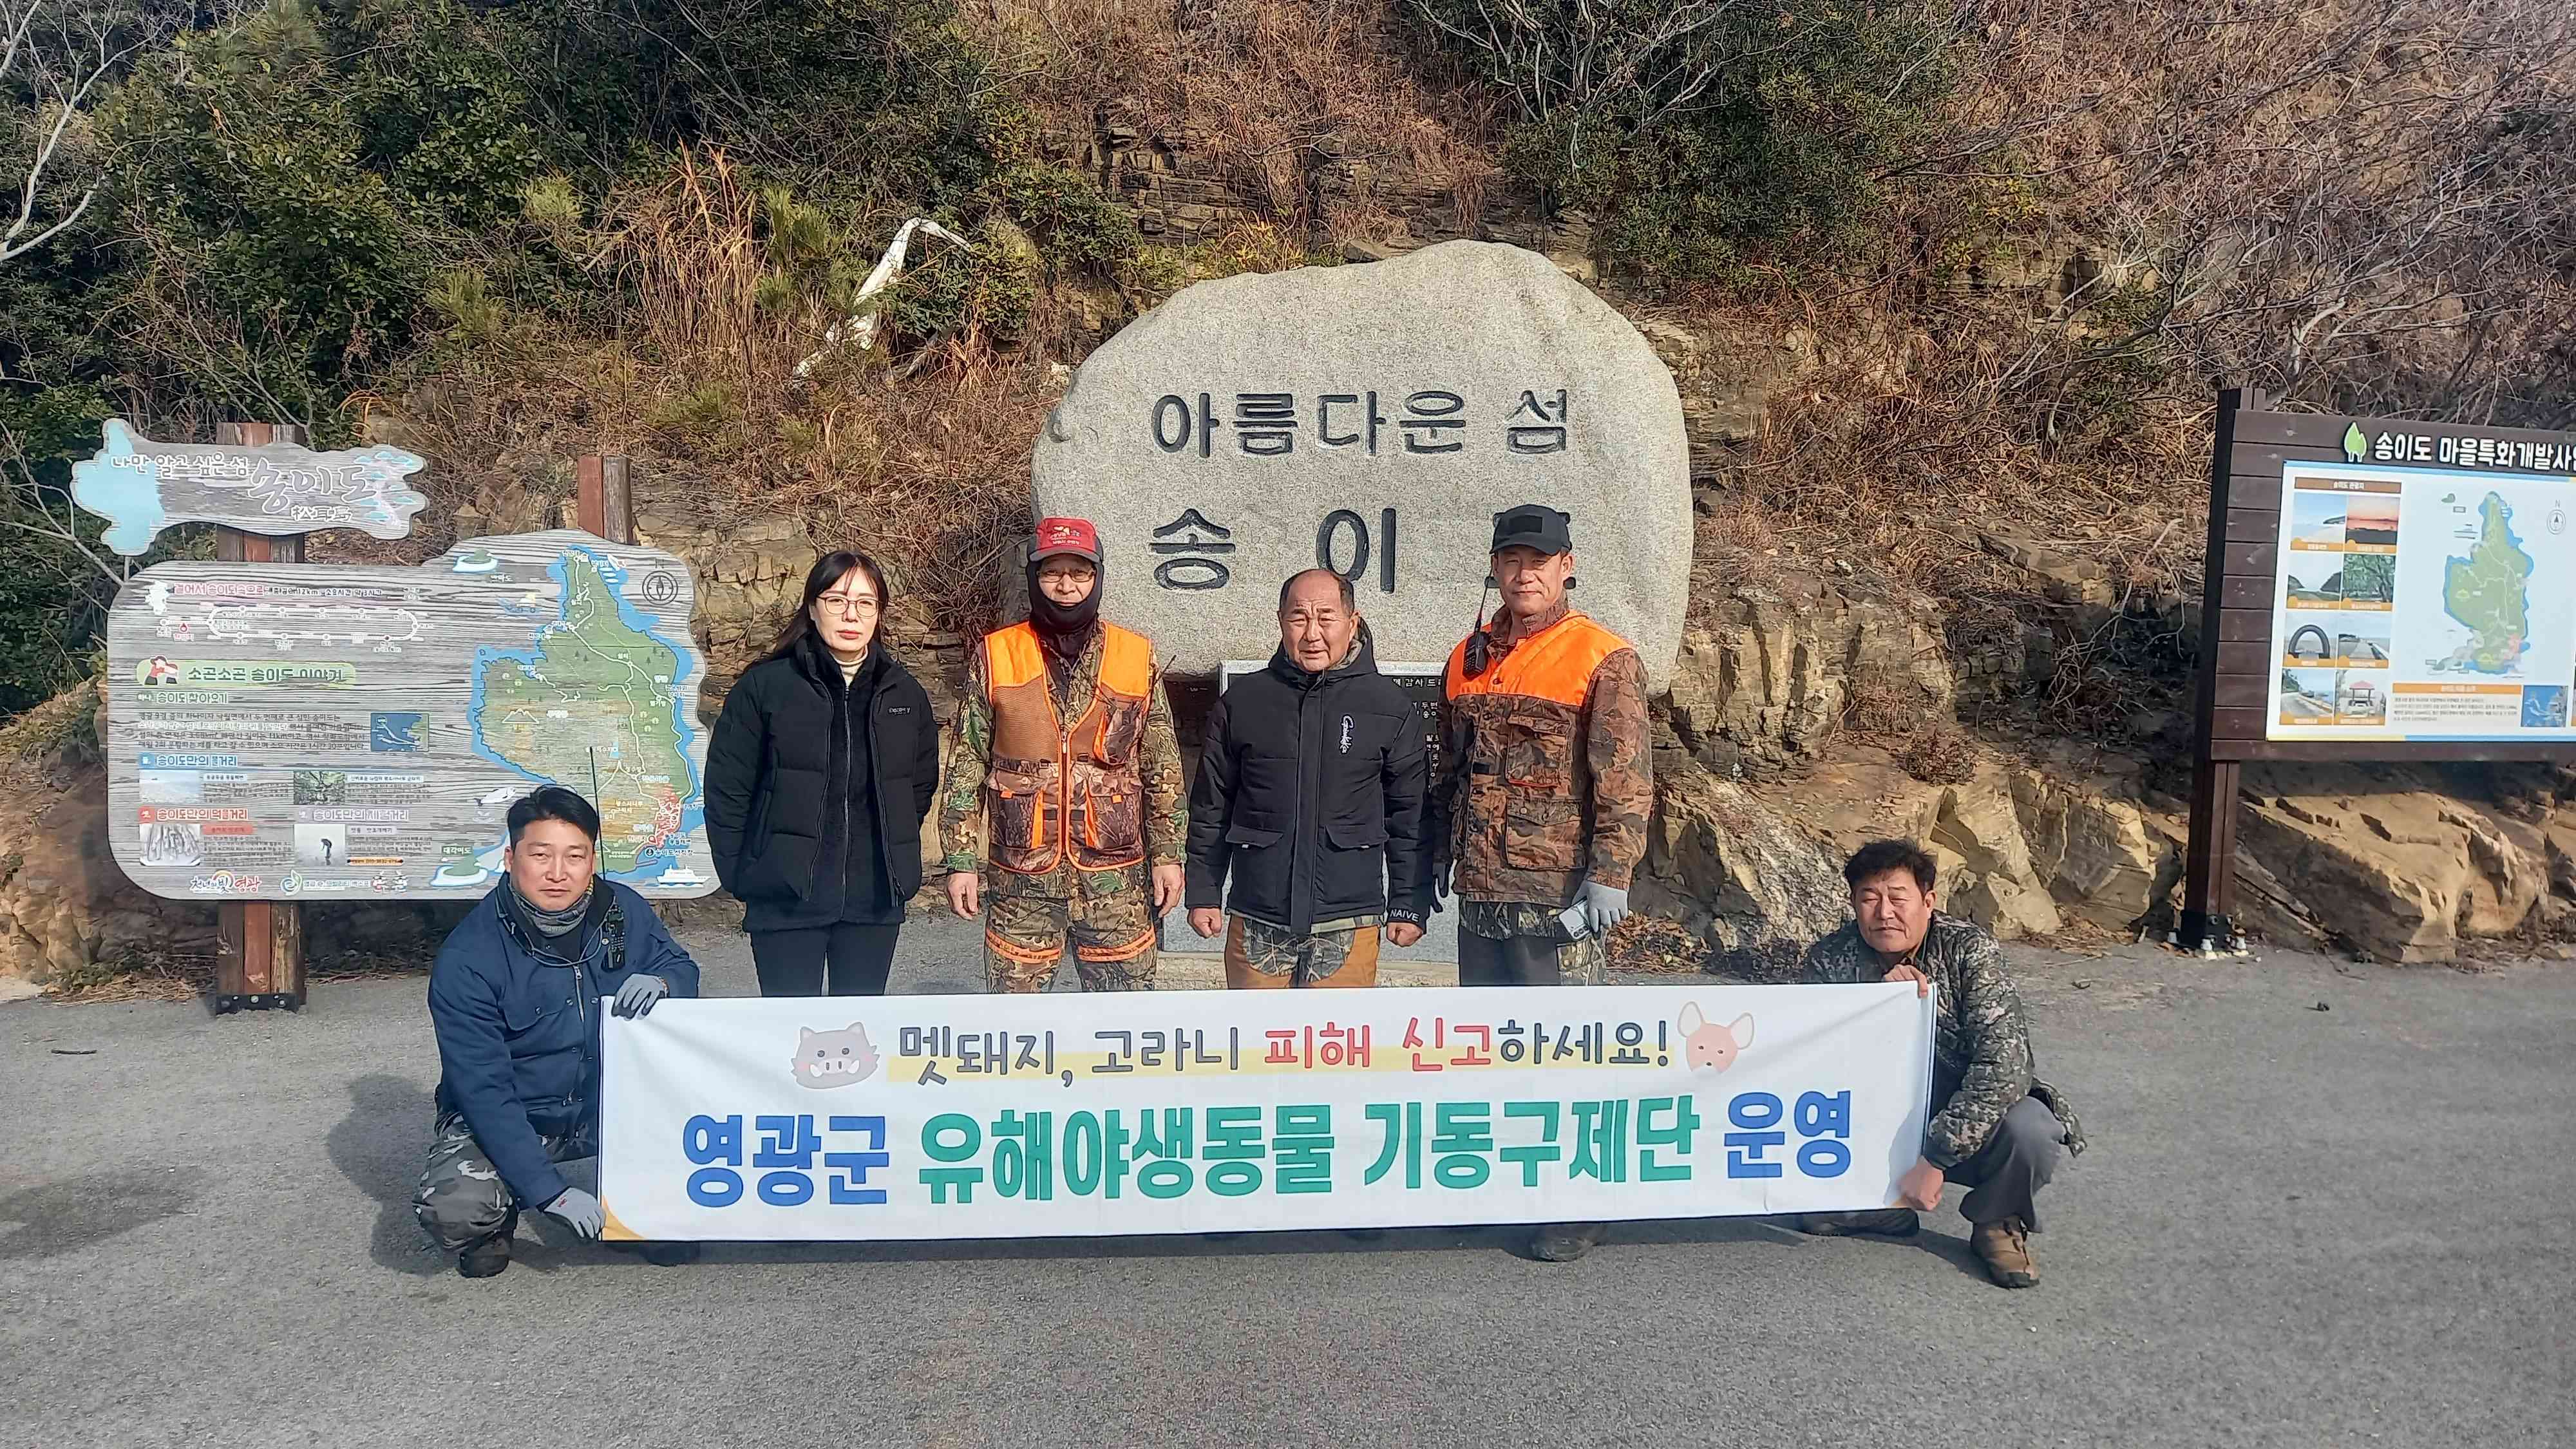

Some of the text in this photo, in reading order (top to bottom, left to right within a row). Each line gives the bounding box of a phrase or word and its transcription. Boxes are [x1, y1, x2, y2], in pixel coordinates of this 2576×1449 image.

[1151, 389, 1567, 457] 아름다운 섬
[2374, 432, 2576, 472] 송이도 마을특화개발사
[111, 451, 249, 476] 나만 알고 싶은 섬
[249, 458, 377, 513] 송이도
[188, 668, 246, 681] 소곤소곤
[251, 668, 294, 681] 송이도
[1405, 678, 1423, 687] 감사
[158, 692, 186, 703] 송이도
[188, 692, 228, 703] 찾아오기
[157, 755, 209, 766] 송이도만의
[157, 809, 209, 820] 송이도만의
[212, 810, 248, 820] 먹을거리
[314, 809, 366, 820] 송이도만의
[366, 810, 409, 820] 체험거리
[234, 875, 261, 893] 영광
[1390, 909, 1419, 922] NAIVE
[899, 1016, 1669, 1087] 멧돼지, 고라니 피해 신고하세요!
[683, 1090, 1852, 1207] 영광군 유해야생동물 기동구제단 운영
